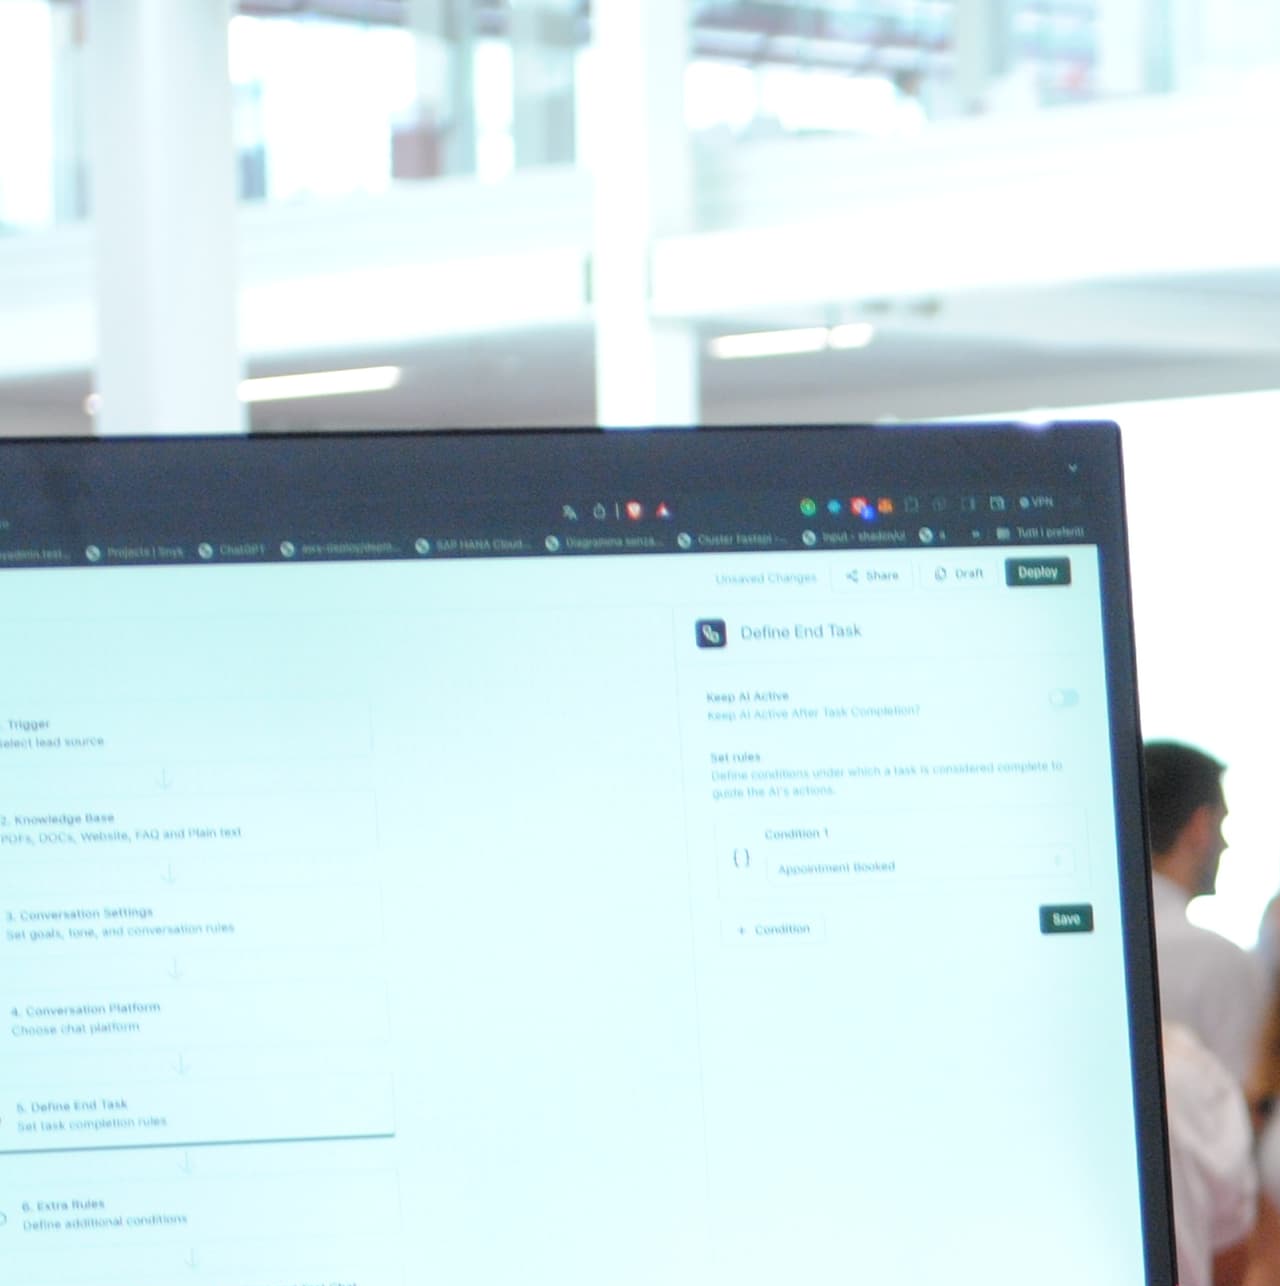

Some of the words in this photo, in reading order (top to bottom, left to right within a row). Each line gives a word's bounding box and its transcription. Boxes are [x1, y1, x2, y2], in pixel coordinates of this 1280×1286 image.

[1031, 496, 1055, 508] VPN
[715, 571, 764, 585] Unsaved
[768, 570, 817, 588] Changes
[865, 569, 900, 582] Share
[954, 566, 984, 581] Draft
[1018, 564, 1059, 581] Deploy
[740, 623, 790, 641] Define
[795, 622, 824, 639] End
[827, 620, 862, 639] Task
[706, 690, 735, 705] Keep
[753, 688, 790, 703] Active
[707, 709, 736, 723] Keep
[754, 707, 788, 721] Active
[8, 719, 50, 733] Trigger
[36, 735, 61, 748] lead
[64, 735, 105, 747] source
[710, 751, 729, 764] Set
[732, 750, 761, 763] rules
[711, 768, 749, 782] Define
[751, 766, 810, 781] conditions
[812, 765, 845, 779] under
[847, 764, 882, 778] which
[894, 763, 917, 777] task
[932, 760, 994, 776] considered
[996, 759, 1049, 776] complete
[1051, 758, 1063, 772] to
[747, 784, 765, 798] the
[14, 814, 82, 828] Knowledge
[85, 812, 115, 826] Base
[135, 828, 160, 842] FAQ
[163, 827, 185, 839] and
[188, 826, 217, 839] Plain
[219, 825, 242, 838] text
[764, 825, 820, 841] Condition
[777, 860, 851, 877] Appointment
[853, 858, 896, 873] Booked
[20, 908, 100, 922] Conversation
[103, 905, 154, 921] Settings
[1052, 910, 1081, 926] Save
[6, 928, 26, 943] Set
[102, 925, 125, 937] and
[127, 922, 201, 937] conversation
[205, 920, 236, 934] rules
[755, 921, 811, 937] Condition
[26, 1002, 106, 1017] Conversation
[109, 999, 161, 1014] Platform
[11, 1022, 58, 1037] Choose
[61, 1022, 87, 1035] chat
[90, 1020, 141, 1037] platform
[31, 1099, 71, 1113] Define
[74, 1097, 98, 1111] End
[101, 1096, 128, 1110] Task
[17, 1118, 37, 1132] Set
[40, 1117, 66, 1131] task
[69, 1115, 136, 1132] completion
[138, 1114, 168, 1128] rules
[36, 1199, 69, 1212] Extra
[71, 1197, 105, 1210] Rules
[23, 1217, 62, 1232] Define
[64, 1214, 123, 1230] additional
[126, 1211, 188, 1227] conditions
